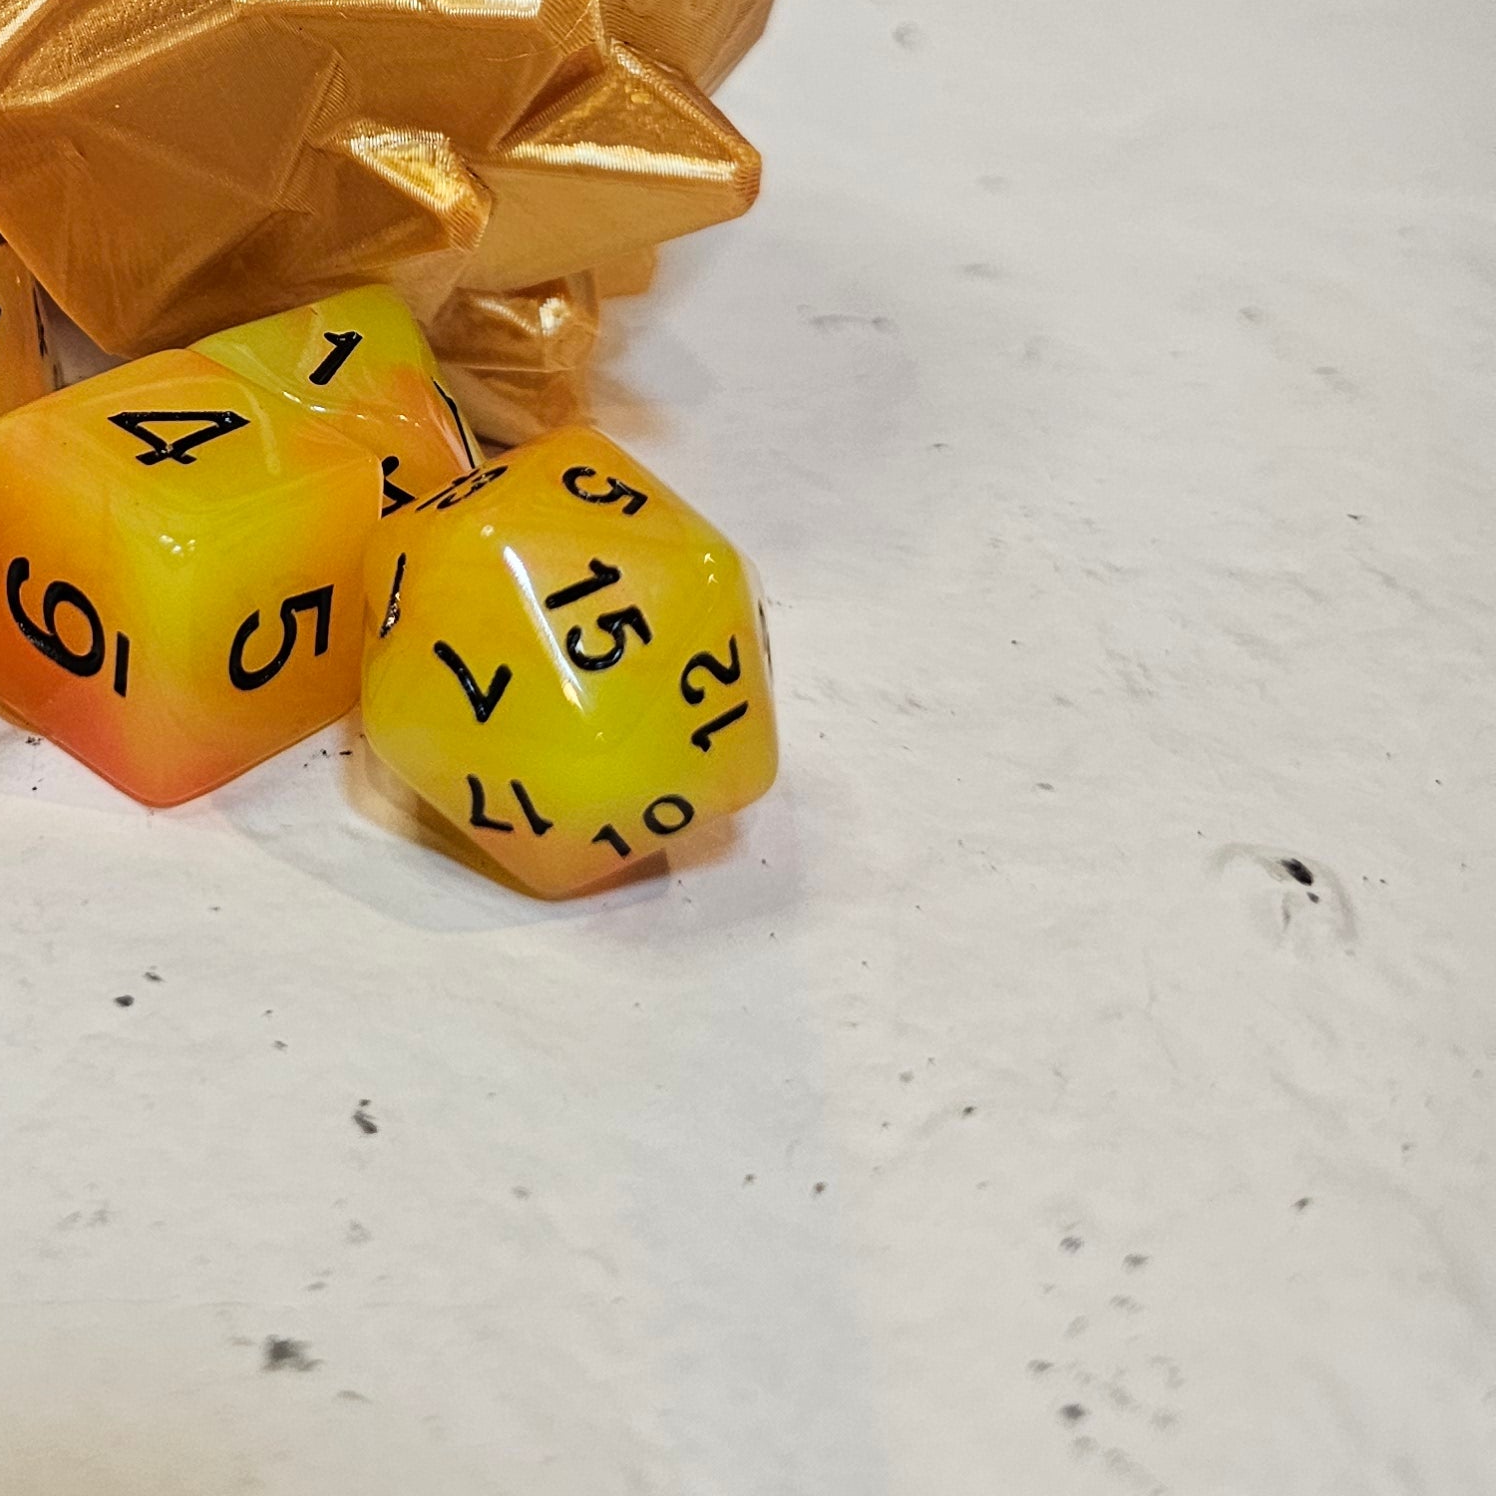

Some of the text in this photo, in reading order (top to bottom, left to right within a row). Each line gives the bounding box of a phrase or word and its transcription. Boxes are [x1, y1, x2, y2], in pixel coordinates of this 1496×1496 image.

[308, 330, 363, 386] 1
[106, 410, 251, 466] 4
[562, 466, 648, 516] 5
[228, 583, 335, 691] 5
[544, 558, 653, 672] 15
[433, 640, 513, 724] 7
[680, 634, 749, 753] 12
[466, 773, 554, 836] 17
[591, 794, 696, 858] 10
